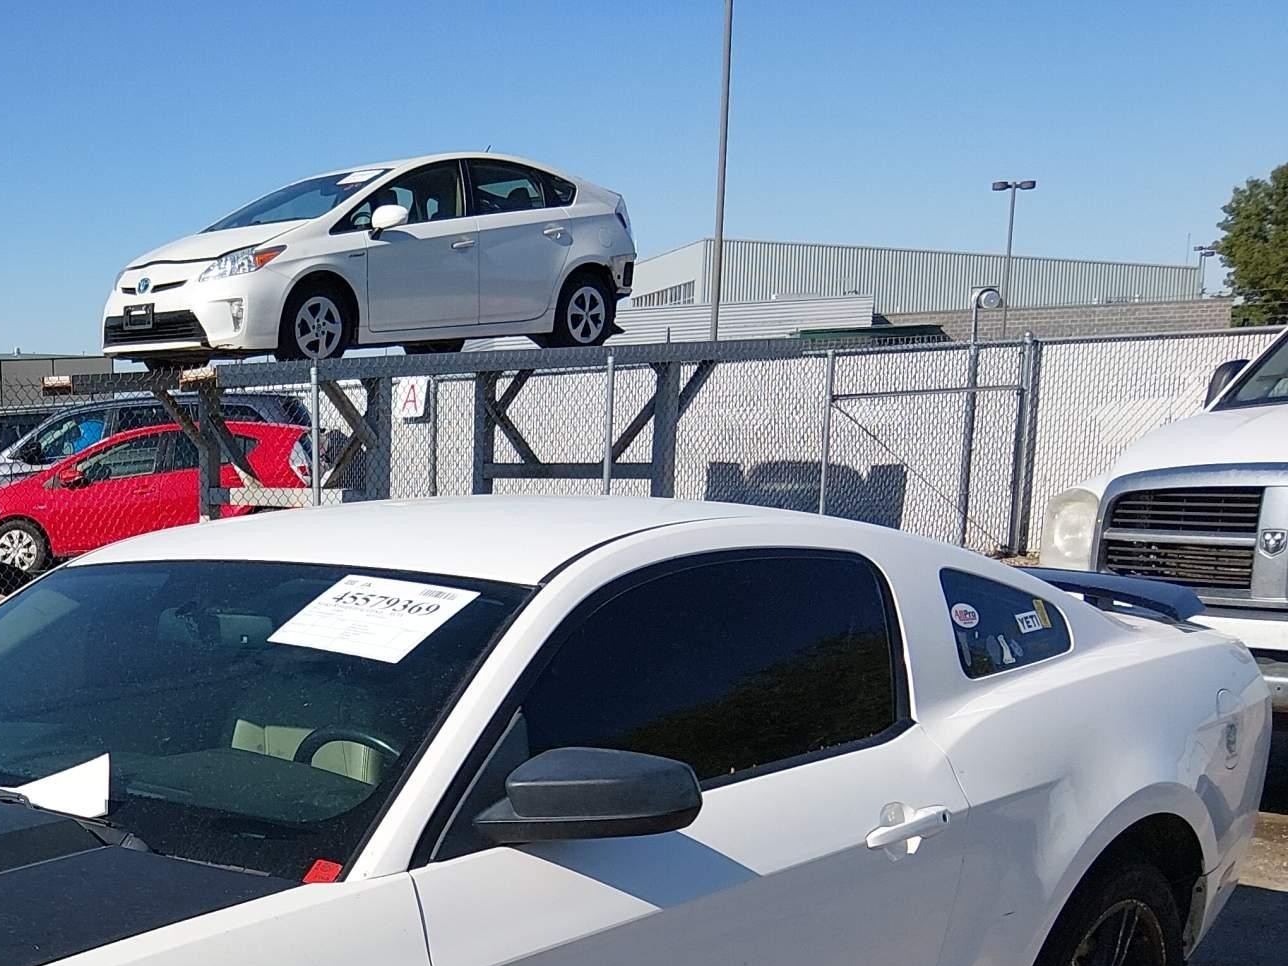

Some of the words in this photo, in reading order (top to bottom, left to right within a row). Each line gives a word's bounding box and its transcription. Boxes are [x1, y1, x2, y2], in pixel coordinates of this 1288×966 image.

[402, 384, 418, 412] A
[332, 590, 441, 617] 45579369
[1017, 614, 1041, 630] YETI
